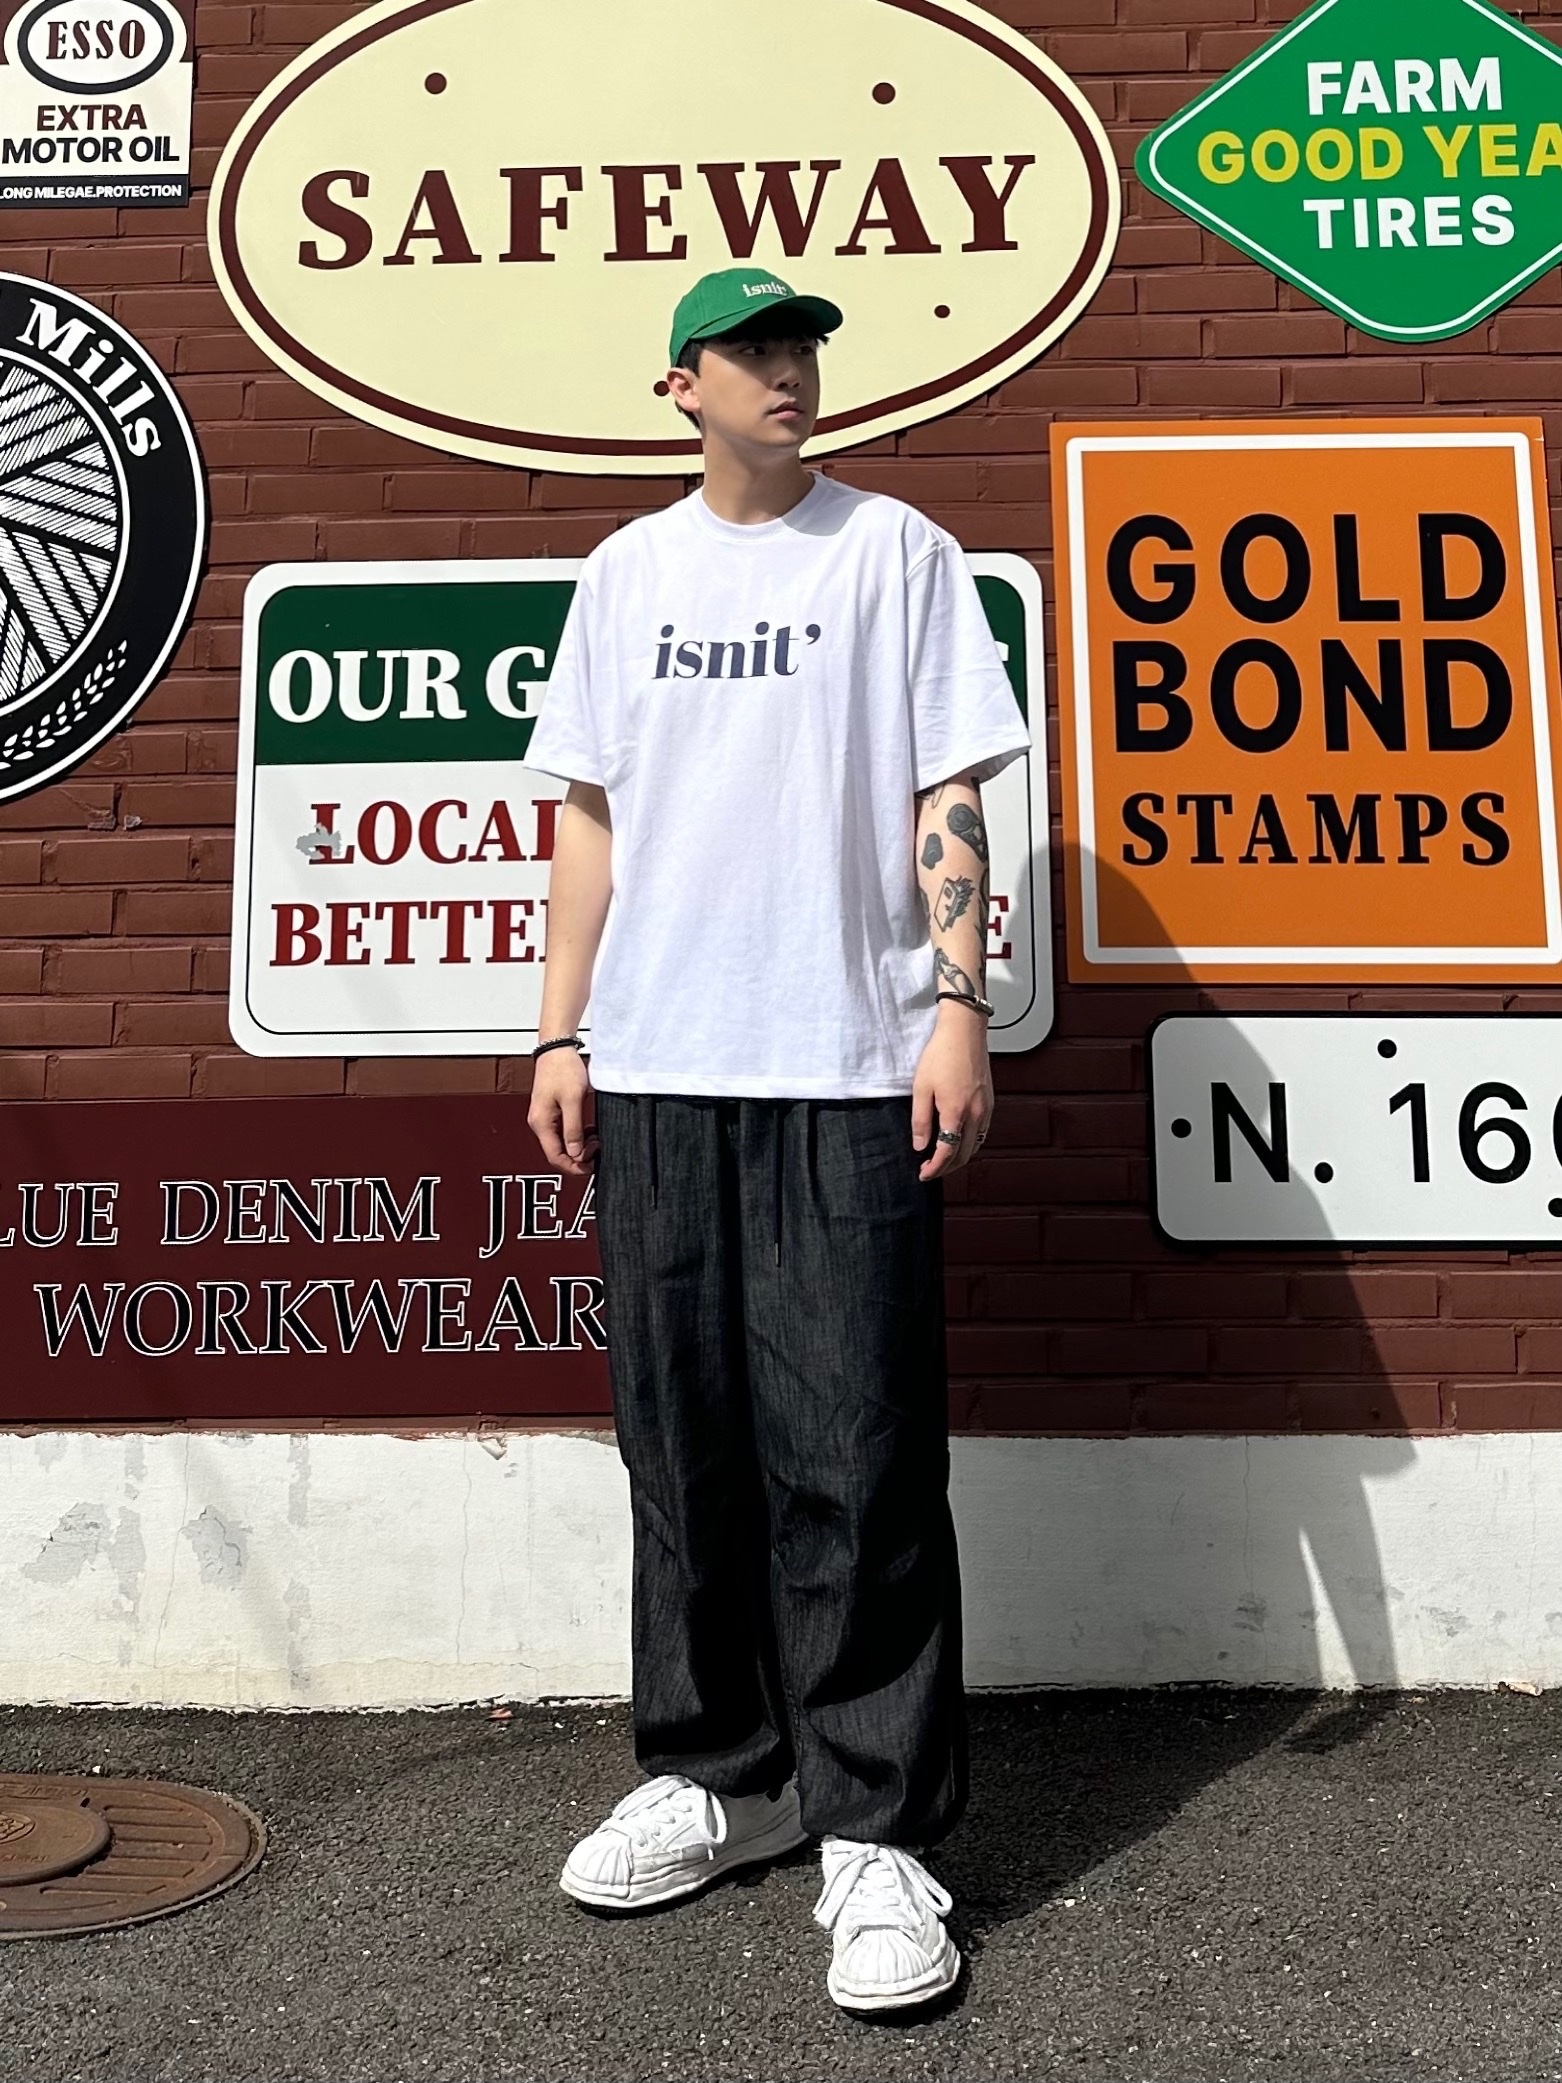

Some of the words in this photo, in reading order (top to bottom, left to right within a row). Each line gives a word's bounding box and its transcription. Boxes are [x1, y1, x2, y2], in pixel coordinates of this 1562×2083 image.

[46, 20, 145, 60] ESSO
[37, 104, 147, 131] EXTRA
[1307, 57, 1503, 116] FARM
[2, 137, 123, 164] MOTOR
[129, 136, 180, 162] OIL
[1198, 127, 1404, 185] GOOD
[298, 154, 1037, 271] SAFEWAY
[1303, 194, 1516, 250] TIRES
[15, 297, 162, 457] Mills
[1106, 513, 1508, 625] GOLD
[268, 649, 468, 724] OUR
[1111, 638, 1514, 754] BOND
[1121, 791, 1511, 867] STAMPS
[269, 899, 550, 967] BETTE
[1389, 1081, 1562, 1185] 16
[159, 1176, 441, 1245] DENIM
[33, 1276, 608, 1357] WORKWEAR
